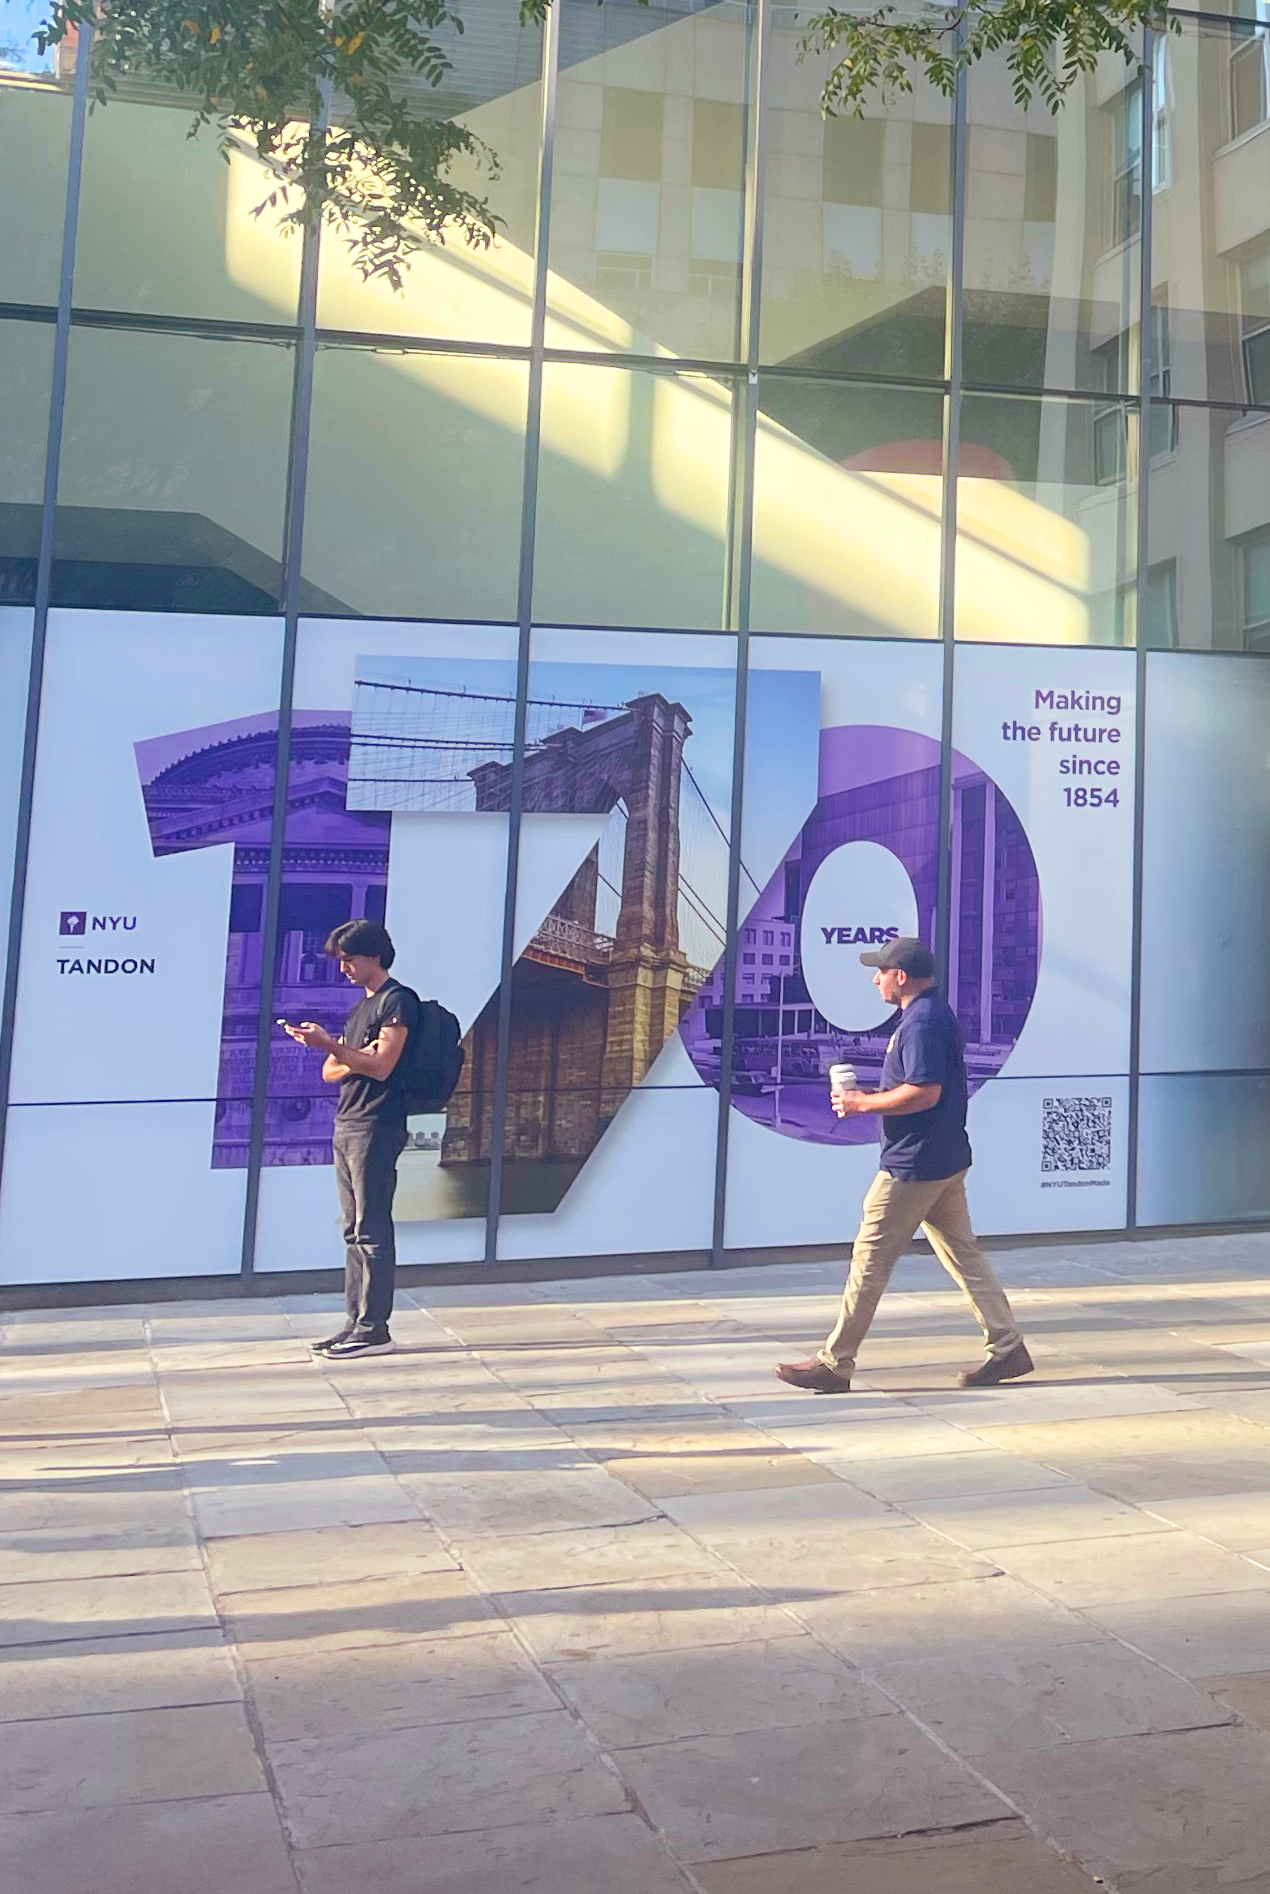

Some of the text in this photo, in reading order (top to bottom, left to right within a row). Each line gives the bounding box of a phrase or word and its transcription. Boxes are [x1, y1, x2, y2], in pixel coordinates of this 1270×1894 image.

[1035, 689, 1122, 715] Making
[1001, 720, 1122, 743] the future
[1059, 754, 1121, 775] since
[1063, 787, 1120, 808] 1854
[91, 916, 137, 930] NYU
[820, 926, 900, 945] YEARS
[56, 959, 155, 974] TANDON
[1041, 1180, 1111, 1188] #NYUTandonMade
